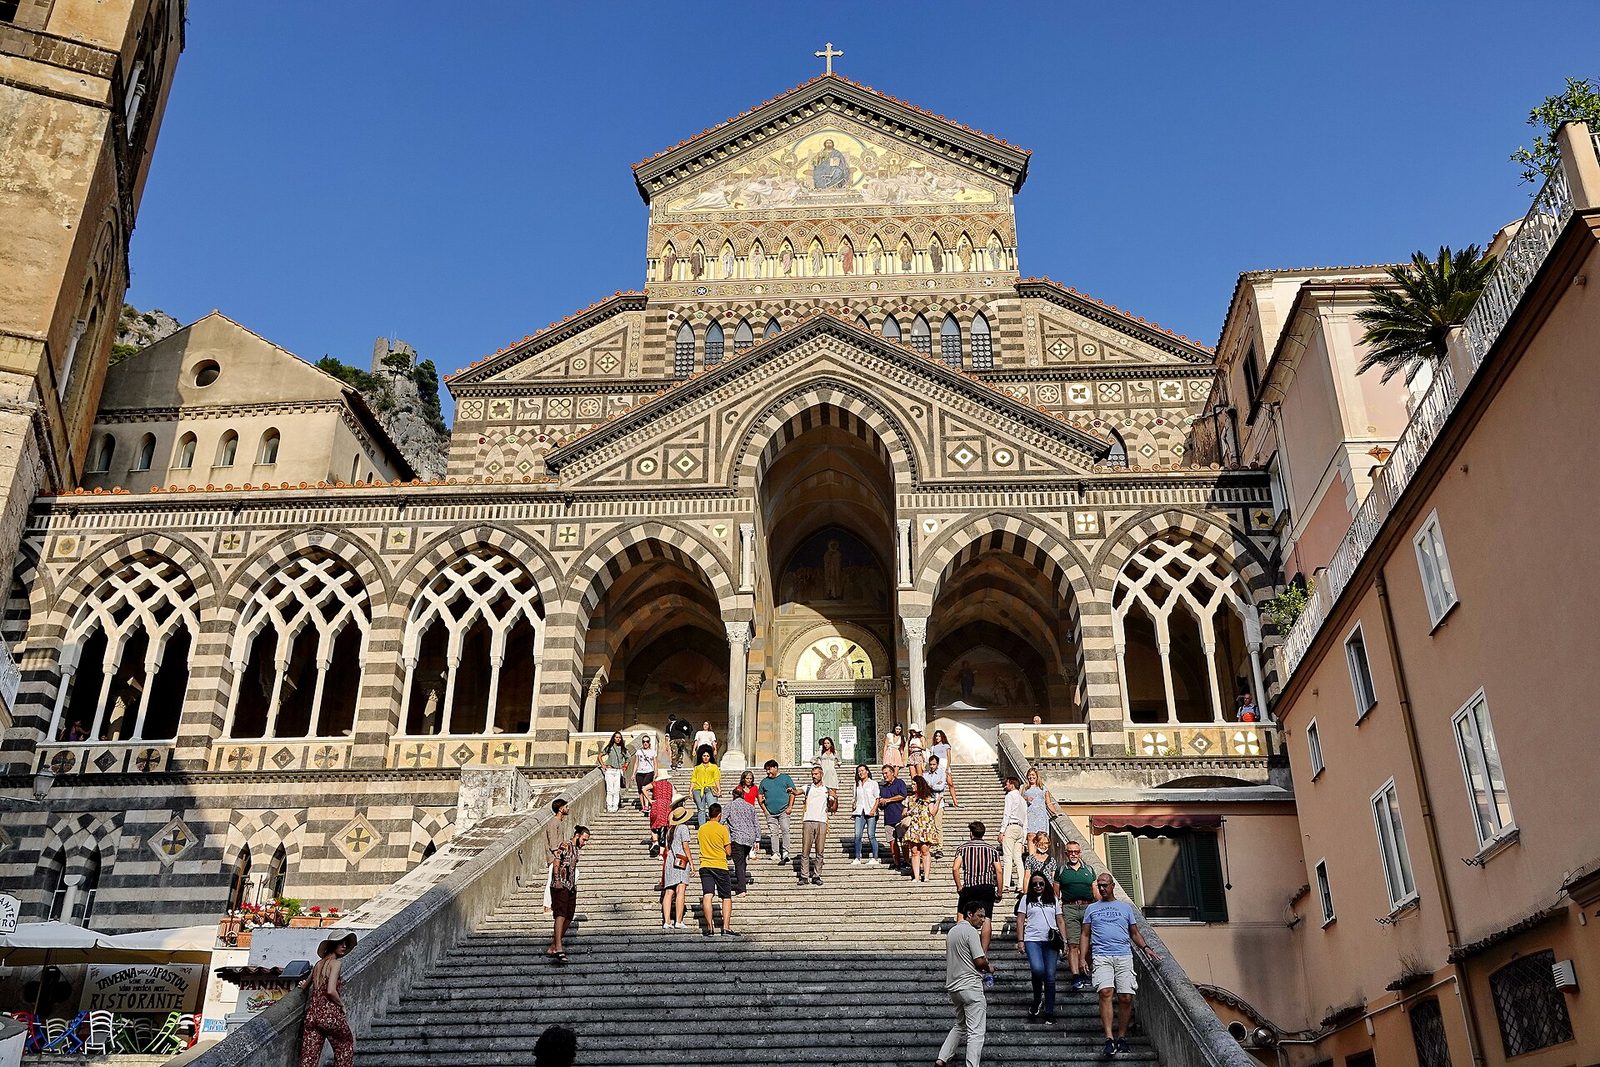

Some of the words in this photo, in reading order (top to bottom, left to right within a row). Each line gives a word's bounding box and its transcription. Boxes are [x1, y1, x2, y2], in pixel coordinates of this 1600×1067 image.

[95, 967, 137, 990] TAVERNA
[150, 966, 189, 993] APOSTOLI
[240, 980, 291, 991] PANINI
[90, 993, 185, 1009] RISTORANTE
